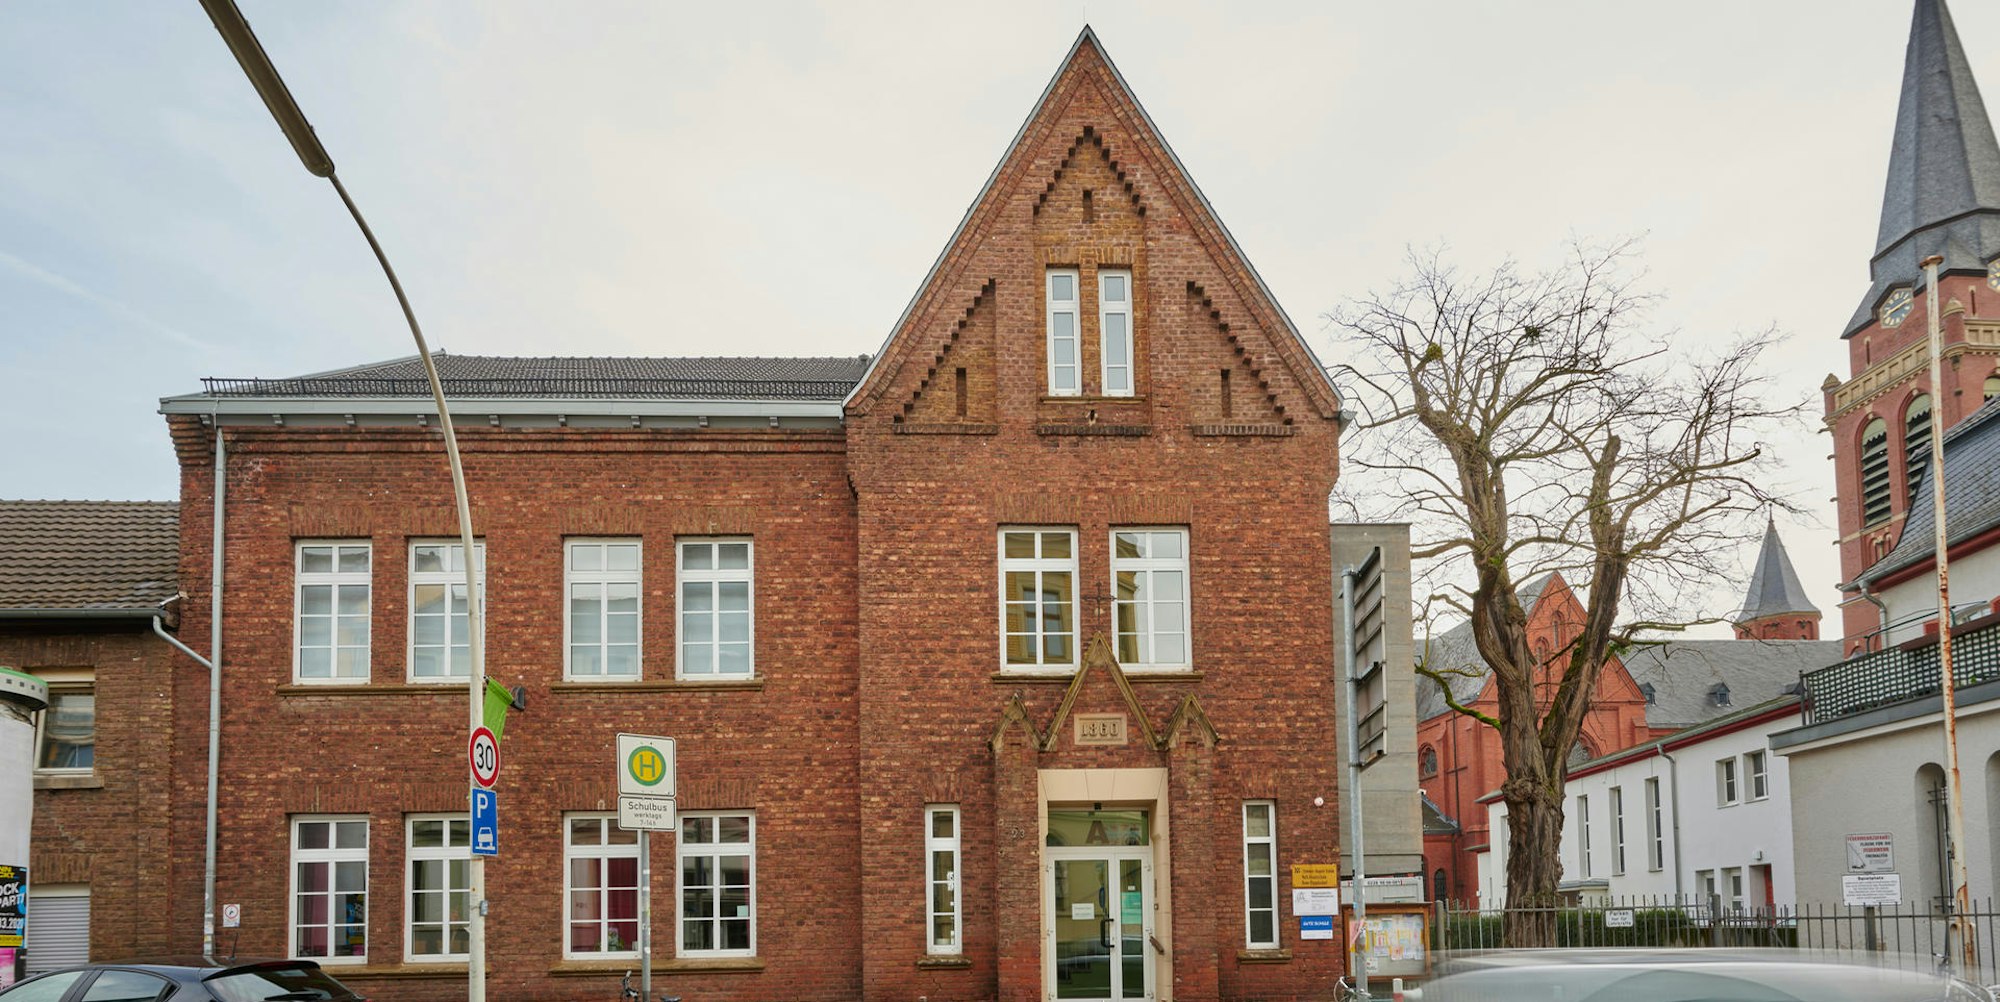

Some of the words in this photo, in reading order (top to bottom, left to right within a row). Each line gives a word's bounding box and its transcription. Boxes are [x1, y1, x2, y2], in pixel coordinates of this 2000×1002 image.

[1081, 722, 1119, 738] 1860
[476, 743, 494, 772] 30
[639, 754, 655, 778] H
[477, 793, 489, 819] P
[628, 801, 667, 812] Schulbus
[633, 812, 662, 820] werktags
